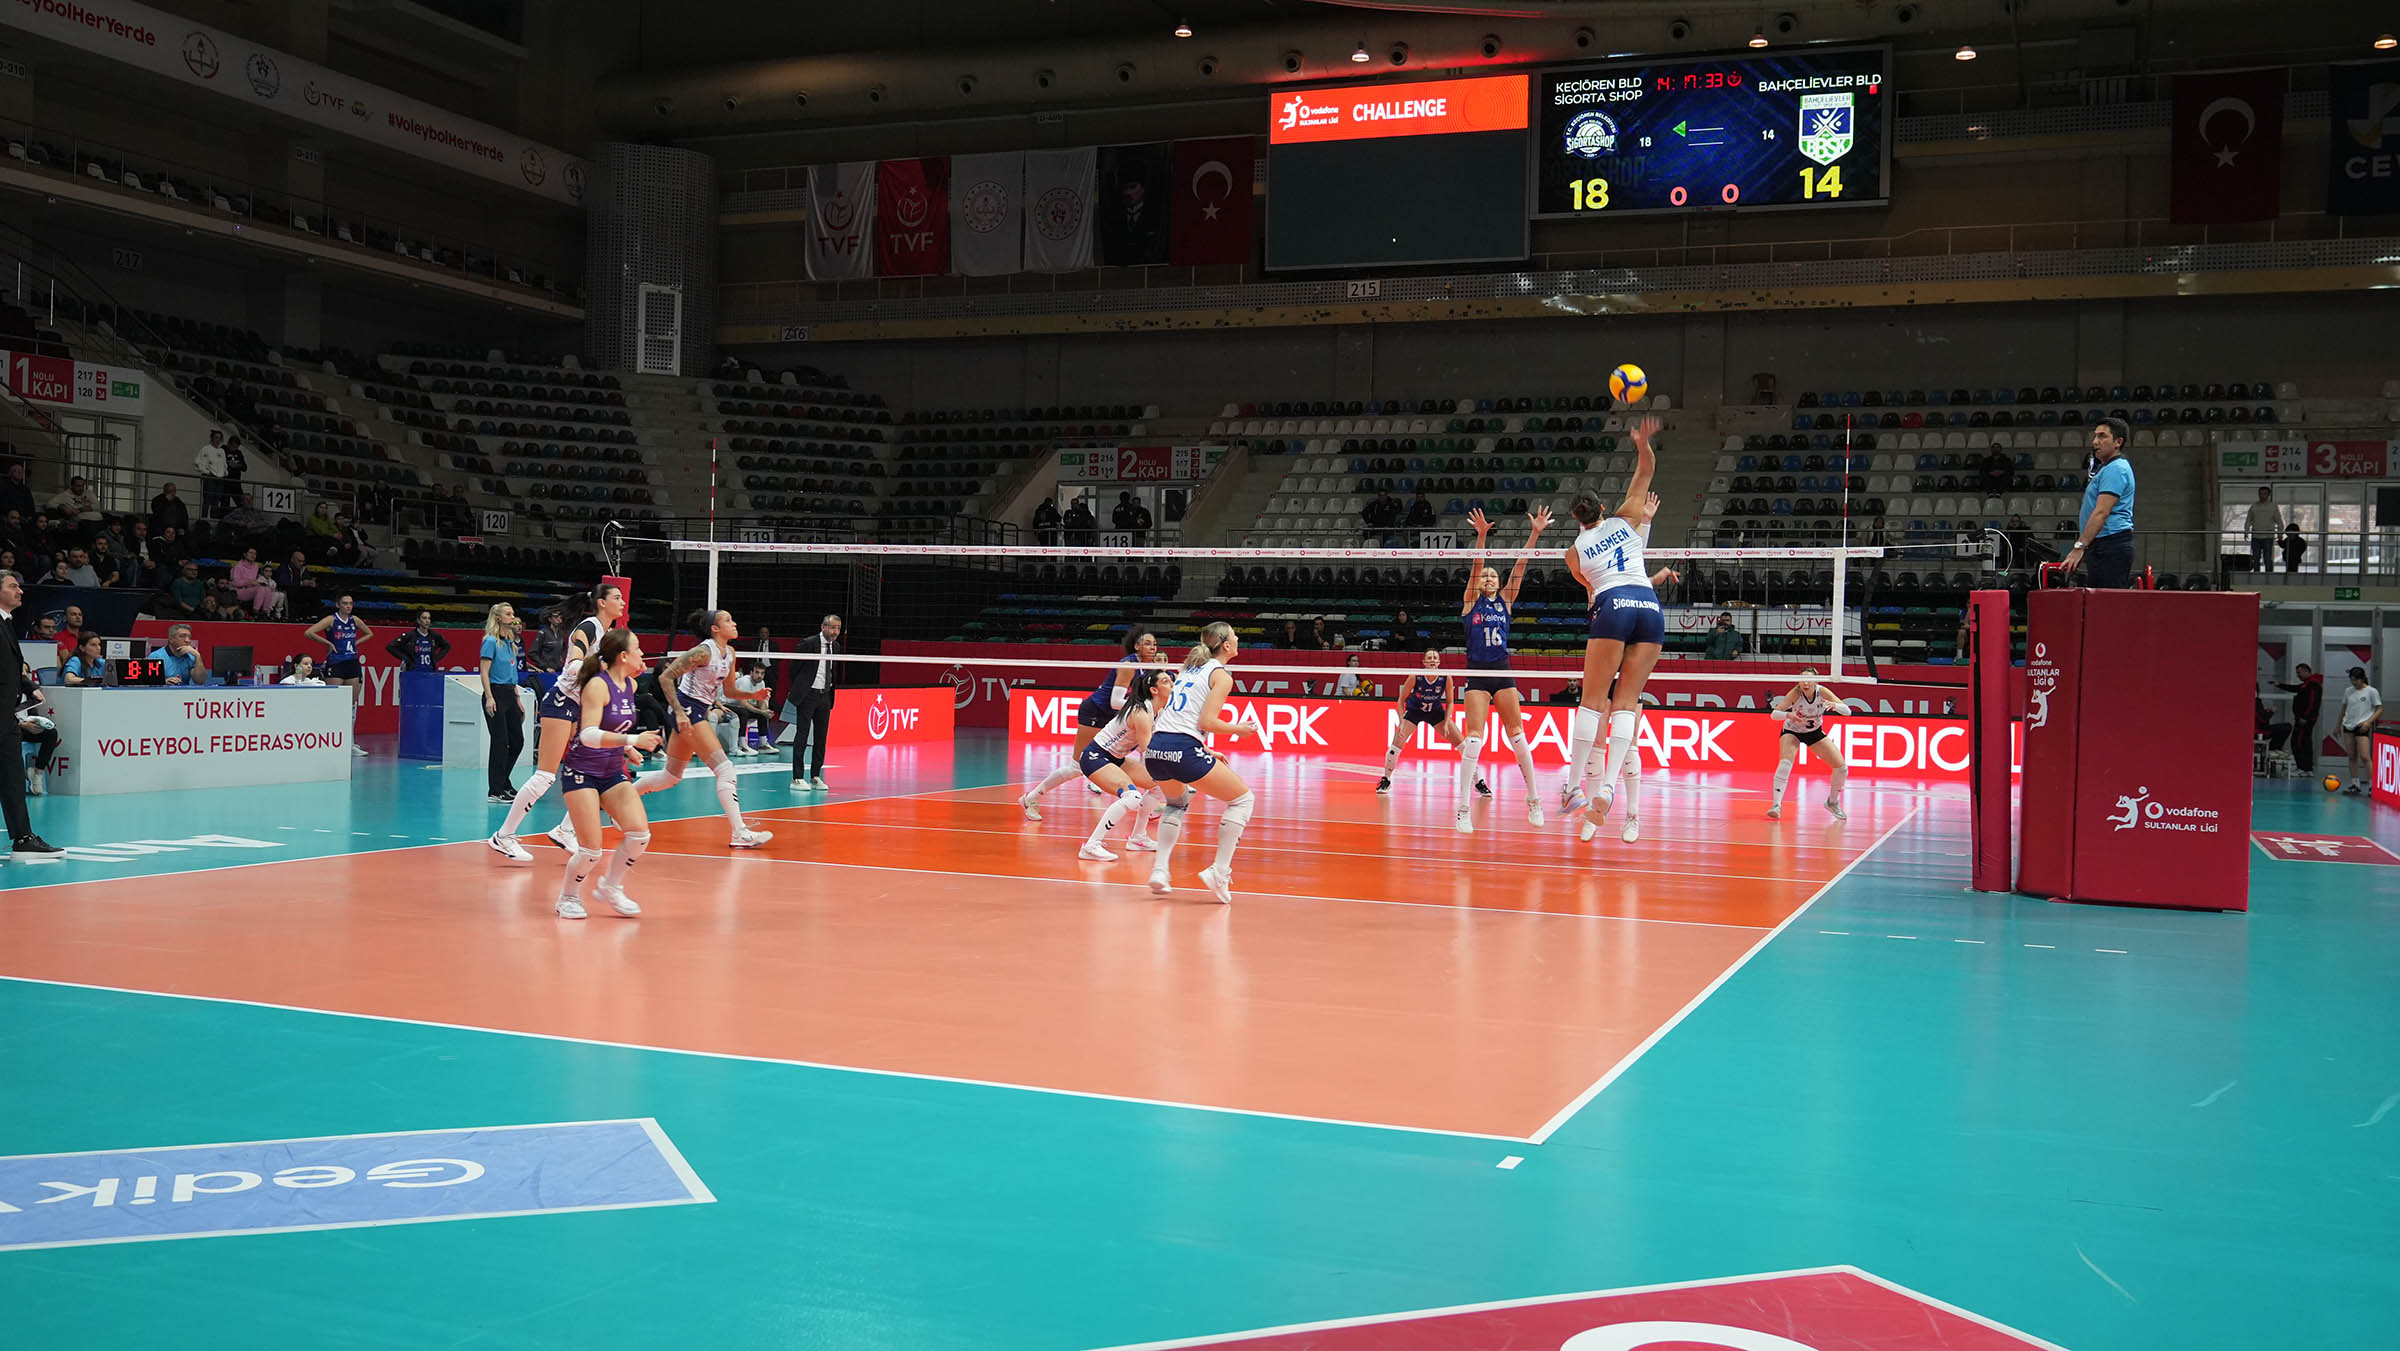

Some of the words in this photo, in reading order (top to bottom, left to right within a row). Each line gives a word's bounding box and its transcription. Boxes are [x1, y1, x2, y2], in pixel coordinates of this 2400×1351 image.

[1555, 79, 1616, 93] KEÇİÖREN
[1618, 77, 1642, 88] BLD
[1758, 76, 1853, 92] BAHÇELİEVLER
[1855, 74, 1882, 86] BLD
[321, 91, 345, 110] TVF
[1554, 92, 1606, 106] SİGORTA
[1609, 90, 1643, 102] SHOP
[1310, 106, 1339, 115] vodafone
[1353, 98, 1447, 122] CHALLENGE
[387, 112, 504, 162] #VoleybolHerYerde
[1639, 136, 1652, 147] 18
[1762, 129, 1775, 140] 14
[1799, 165, 1843, 199] 14
[1569, 177, 1610, 211] 18
[1669, 185, 1688, 207] 0
[1721, 183, 1740, 204] 0
[818, 235, 860, 257] TVF
[890, 232, 934, 256] TVF
[115, 250, 141, 268] 217
[1352, 281, 1378, 297] 215
[78, 370, 93, 381] 217
[32, 381, 68, 400] KAPI
[78, 387, 93, 398] 120
[2282, 447, 2301, 455] 214
[2315, 444, 2337, 474] 3
[1120, 449, 1138, 478] 2
[1138, 465, 1169, 478] KAPI
[2282, 463, 2301, 471] 116
[2340, 462, 2379, 474] KAPI
[266, 491, 293, 509] 121
[485, 513, 506, 530] 120
[743, 531, 771, 544] 119
[1103, 535, 1129, 547] 118
[1423, 535, 1451, 548] 117
[1583, 528, 1630, 560] YAASMEEN
[1607, 546, 1630, 572] 4
[1807, 617, 1833, 629] TVF
[1483, 626, 1503, 647] 16
[419, 654, 431, 666] 10
[2027, 668, 2060, 677] ULTANLAR
[981, 677, 1036, 702] TV
[183, 697, 266, 719] TÜRKİYE
[891, 708, 920, 731] TVF
[1805, 720, 1815, 729] 3
[97, 736, 204, 757] VOLEYBOL
[210, 731, 343, 753] FEDERASYONU
[1798, 723, 2022, 774] MEDICL
[32, 756, 70, 777] VF
[2166, 807, 2219, 819] vodafone
[2144, 821, 2197, 832] SULTANLAR
[2200, 823, 2218, 833] LİGİ
[34, 1157, 486, 1209] Gedik
